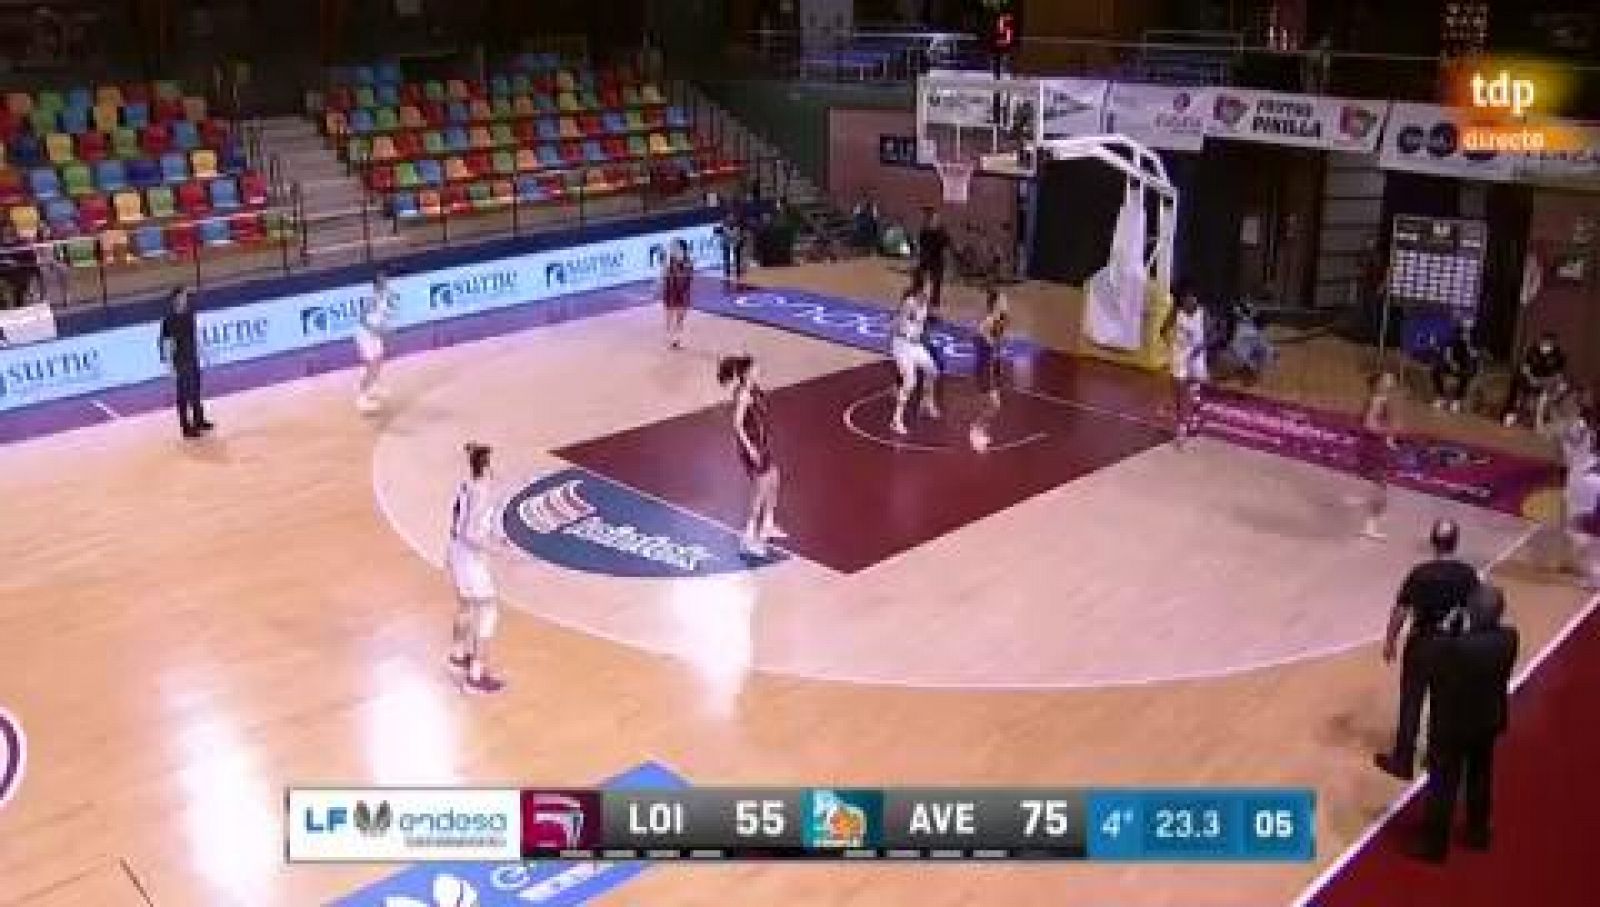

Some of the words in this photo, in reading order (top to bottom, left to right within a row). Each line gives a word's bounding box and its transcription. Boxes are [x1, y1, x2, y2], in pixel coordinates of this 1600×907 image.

[1252, 116, 1321, 138] PINILLA
[566, 248, 625, 276] surne
[453, 269, 518, 298] surne
[201, 318, 269, 348] urne
[6, 346, 99, 385] surne
